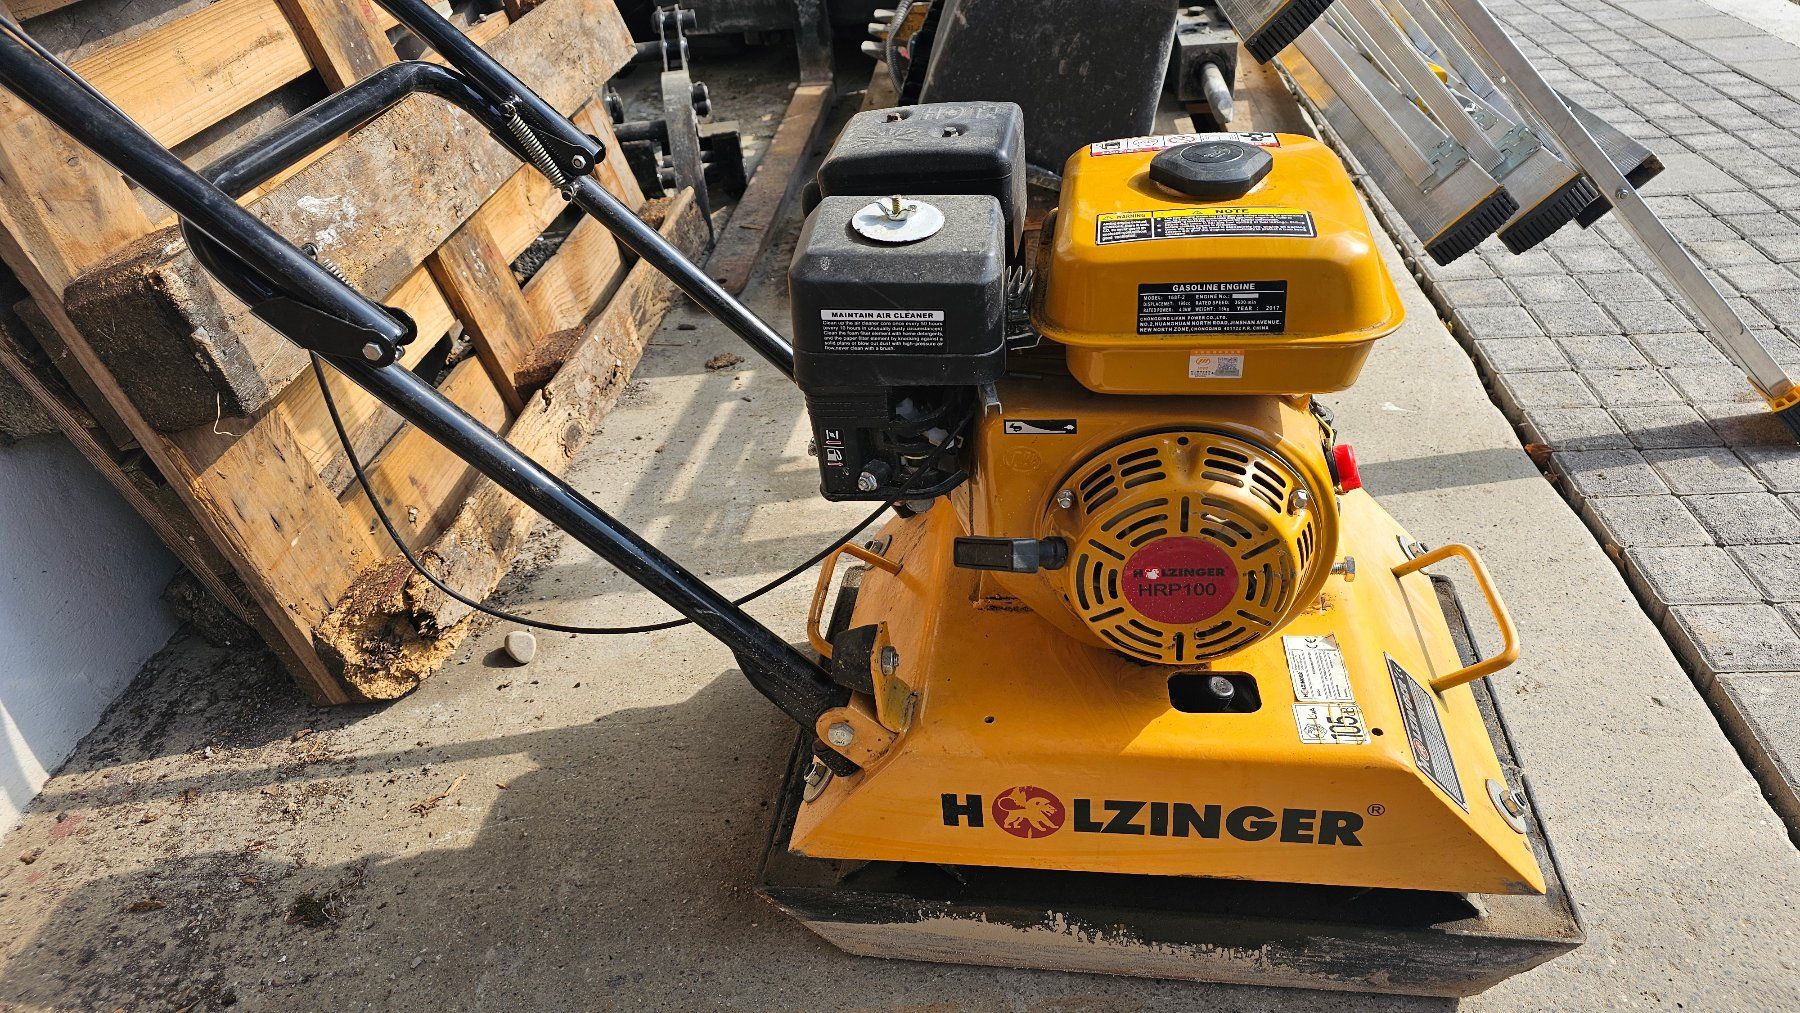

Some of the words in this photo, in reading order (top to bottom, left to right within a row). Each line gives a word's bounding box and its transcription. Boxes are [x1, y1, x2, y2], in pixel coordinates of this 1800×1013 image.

[1172, 284, 1218, 292] GASOLINE
[1220, 283, 1256, 291] ENGINE
[1138, 583, 1216, 596] HRP100
[1325, 716, 1364, 739] 105
